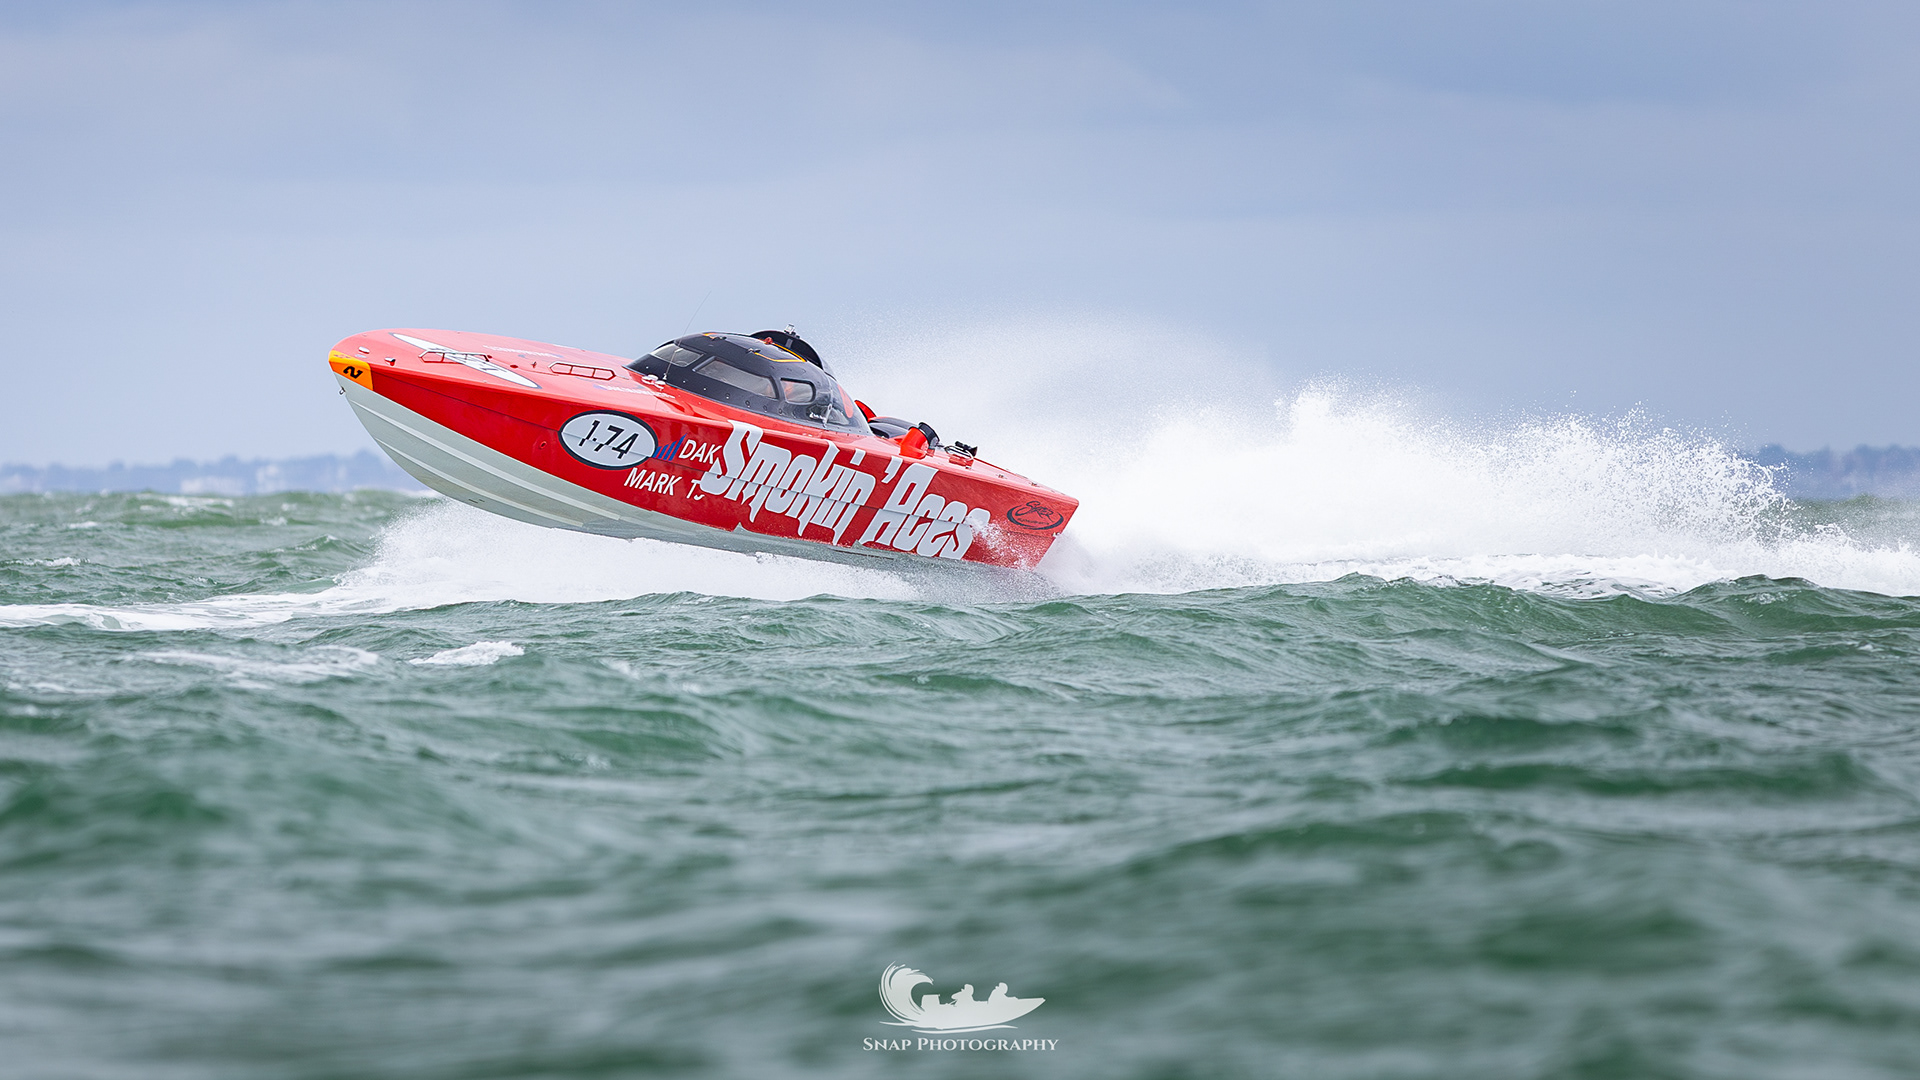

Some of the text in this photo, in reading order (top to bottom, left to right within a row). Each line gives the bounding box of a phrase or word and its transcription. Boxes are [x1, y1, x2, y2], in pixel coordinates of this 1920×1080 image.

[679, 439, 722, 464] DAK
[623, 467, 683, 496] MARK
[858, 463, 991, 560] Aces
